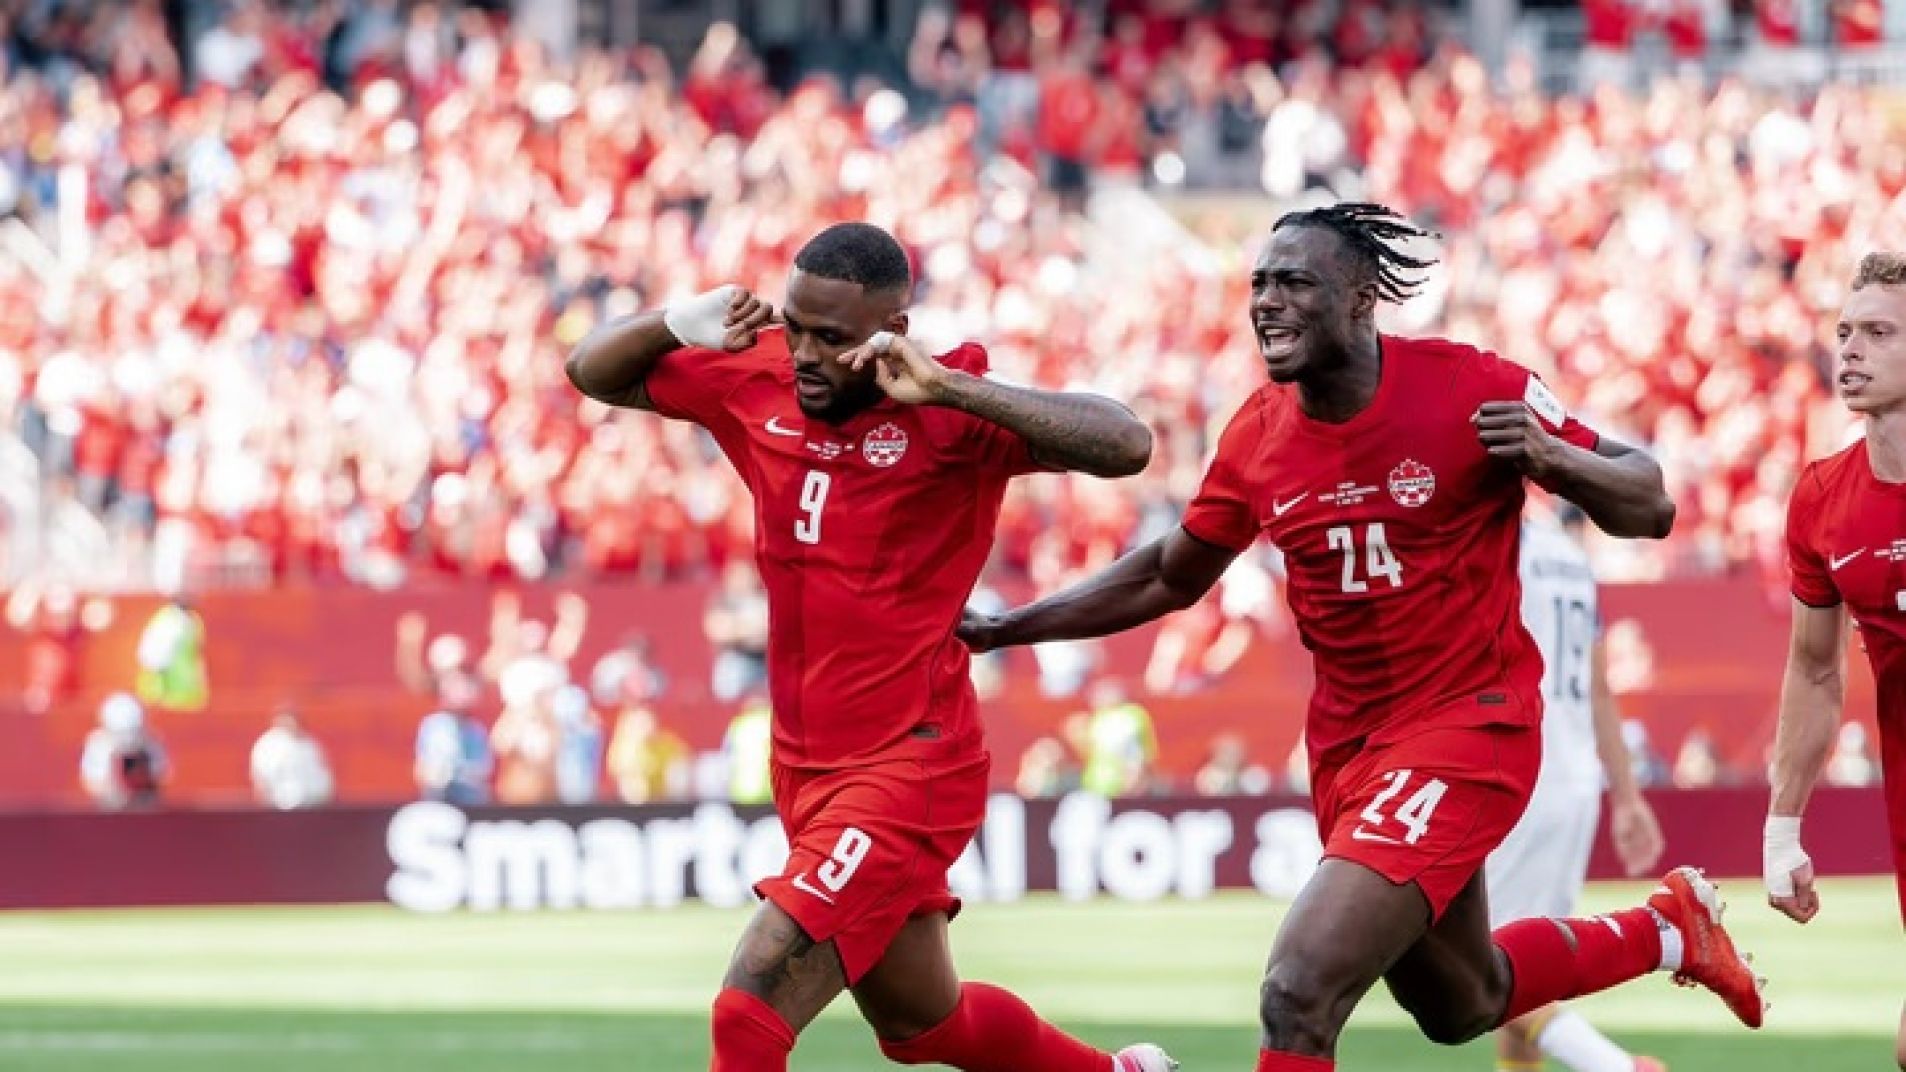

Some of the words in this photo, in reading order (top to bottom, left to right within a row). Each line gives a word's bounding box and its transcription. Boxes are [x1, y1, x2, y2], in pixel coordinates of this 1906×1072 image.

[795, 470, 831, 544] 9
[1327, 523, 1403, 592] 24
[1360, 769, 1448, 844] 24
[818, 827, 872, 892] 9
[1048, 791, 1234, 902] for
